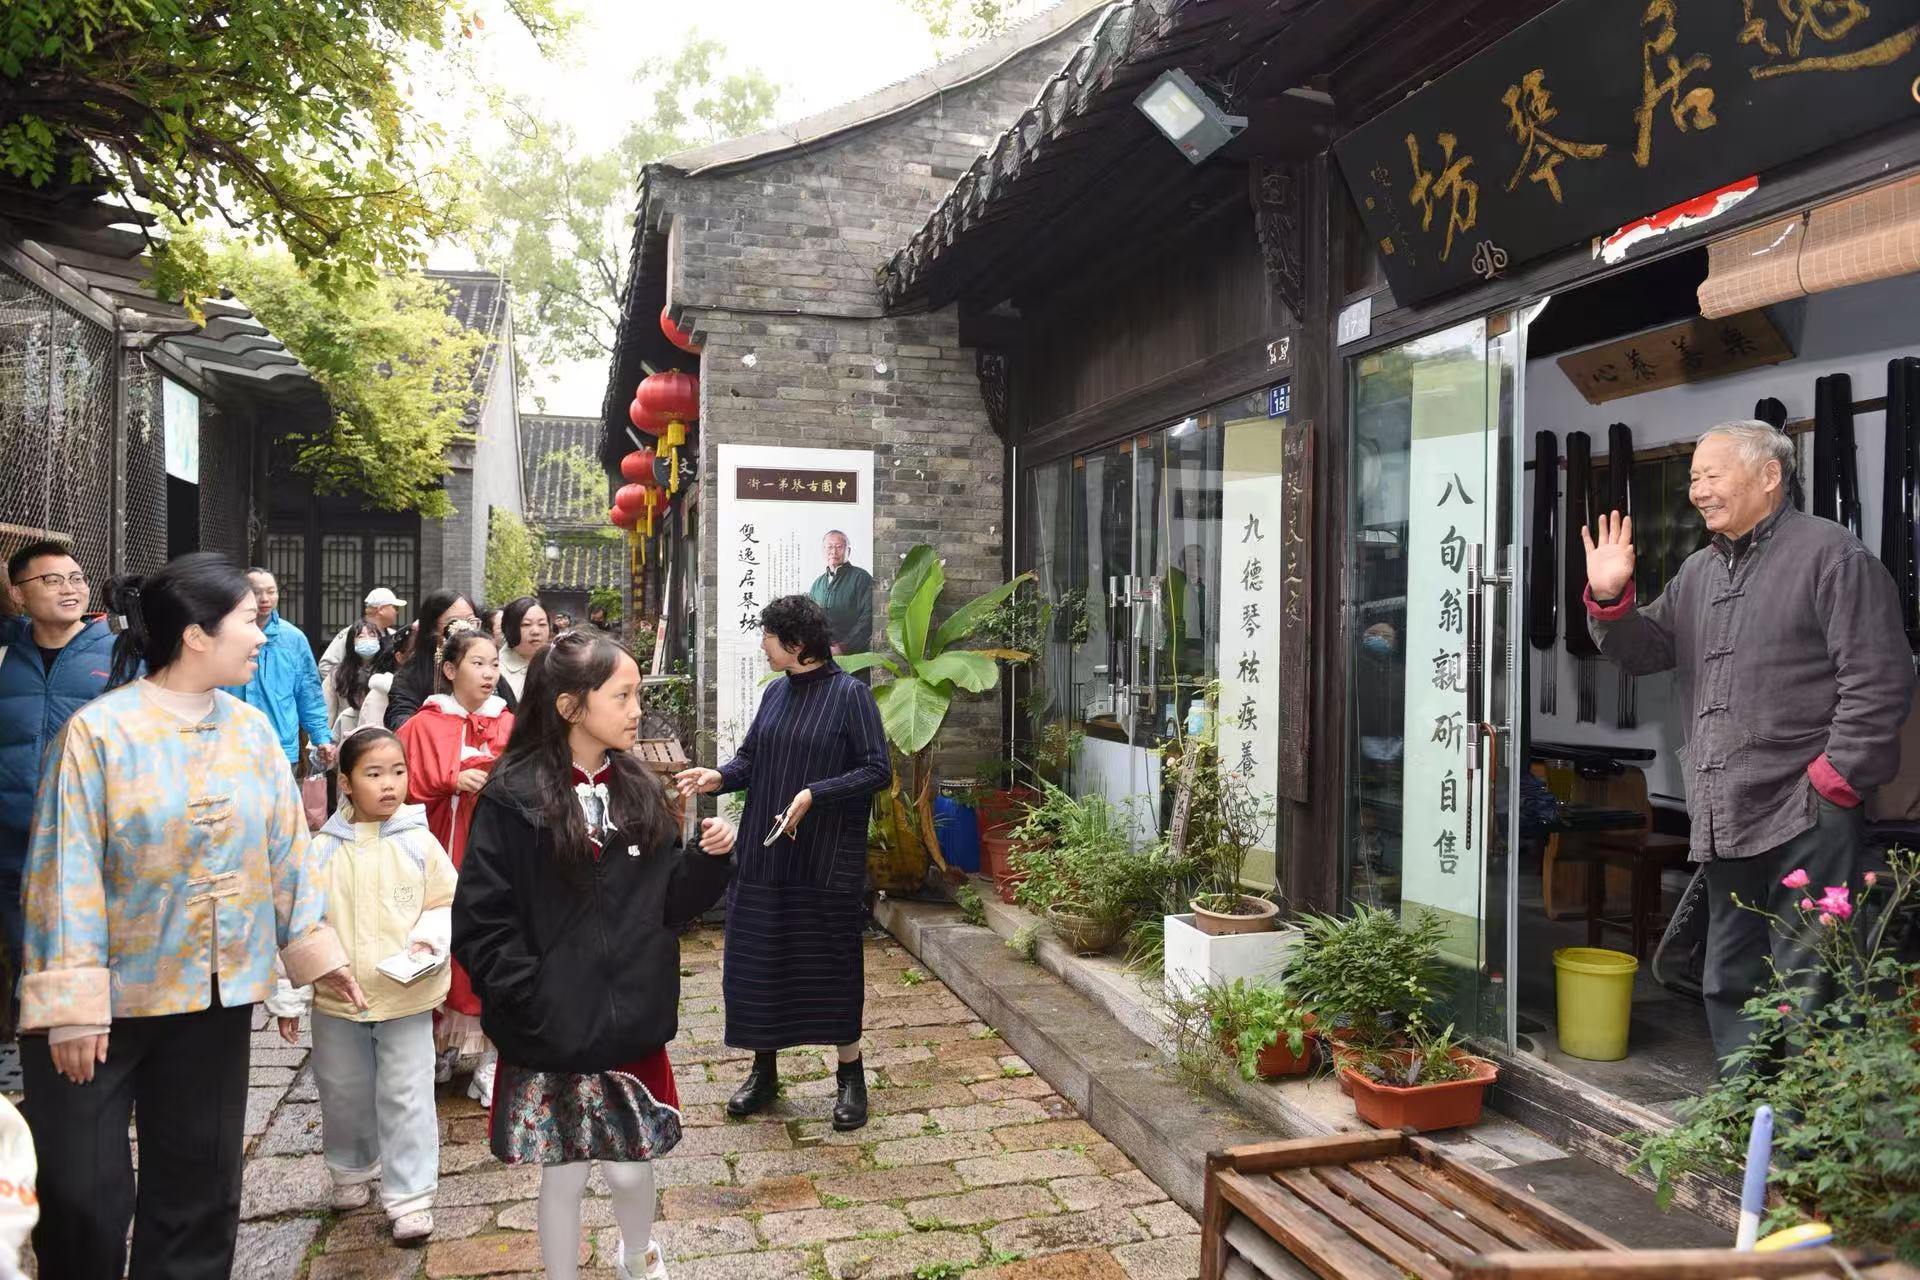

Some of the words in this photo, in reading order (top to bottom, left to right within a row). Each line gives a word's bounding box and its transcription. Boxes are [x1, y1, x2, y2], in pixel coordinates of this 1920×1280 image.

[737, 523, 761, 635] 雙逸居琴坊
